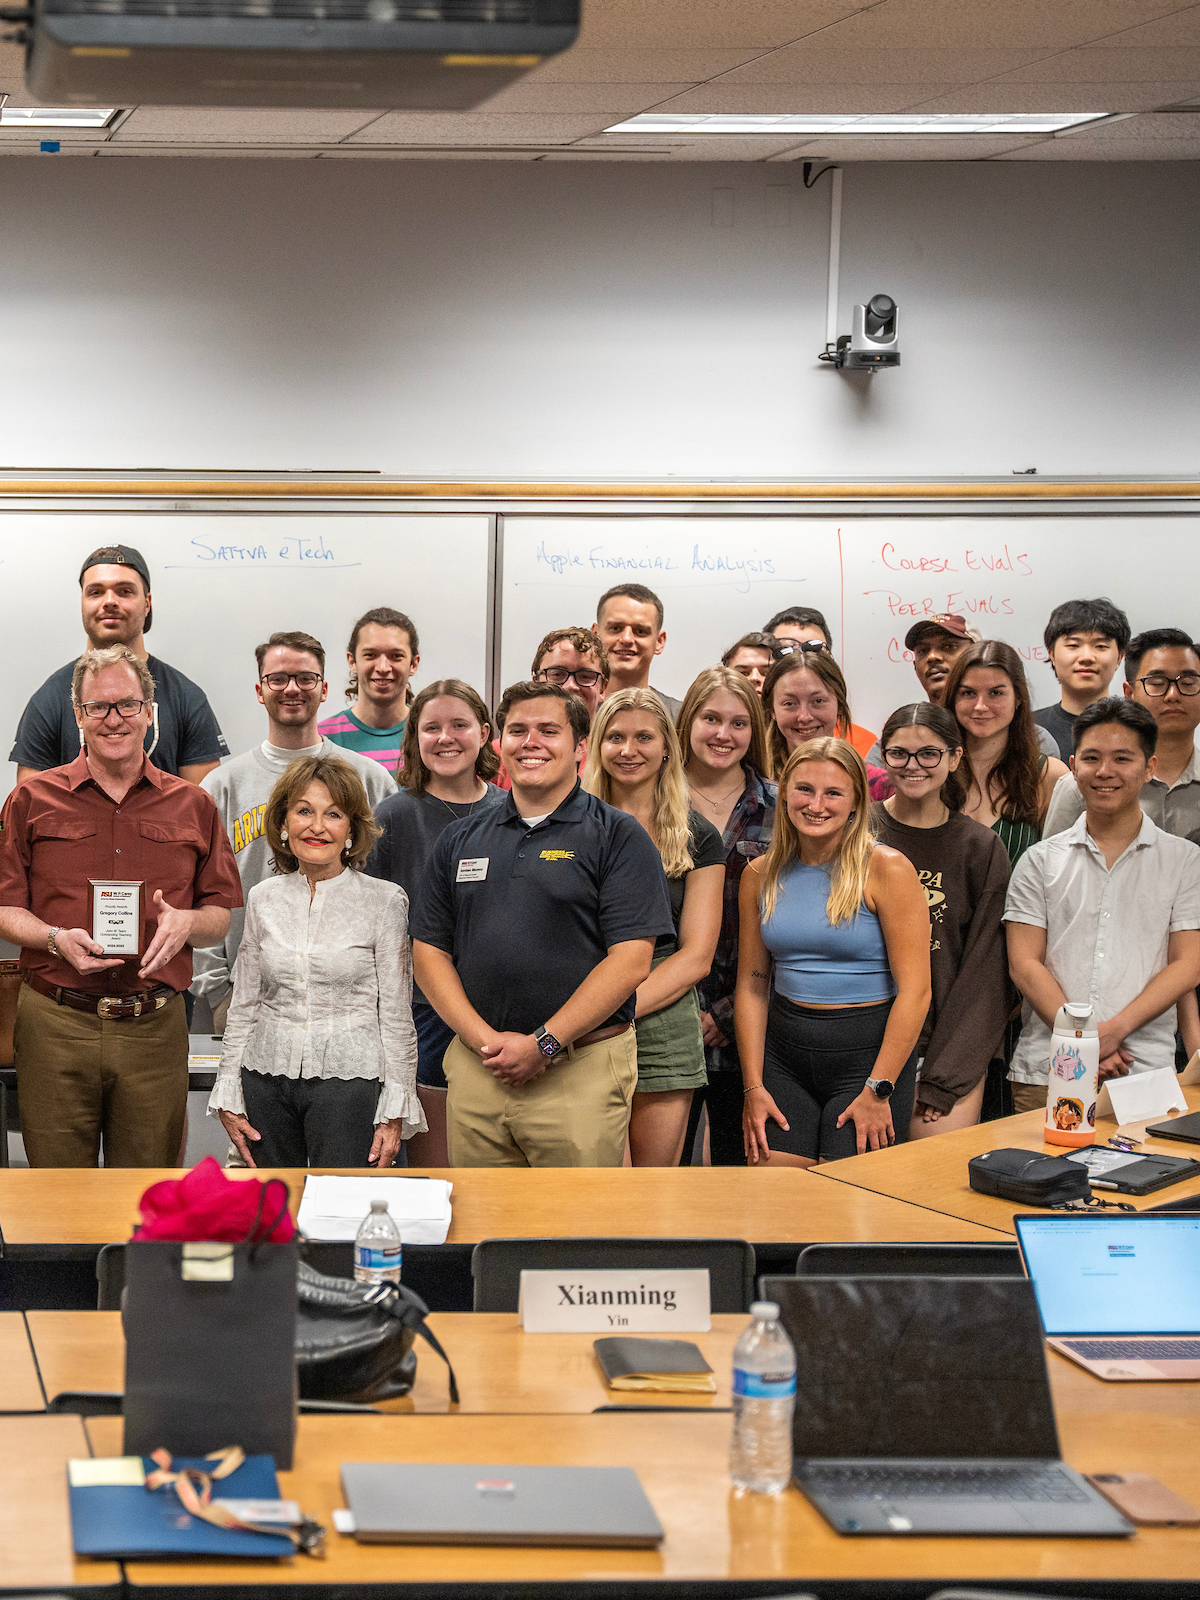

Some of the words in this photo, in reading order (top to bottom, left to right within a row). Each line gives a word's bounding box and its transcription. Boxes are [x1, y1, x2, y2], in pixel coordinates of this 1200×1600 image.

[191, 534, 267, 560] SATTVA
[233, 802, 268, 854] ARIZ
[557, 1284, 677, 1311] Xianming
[607, 1315, 629, 1326] Yin
